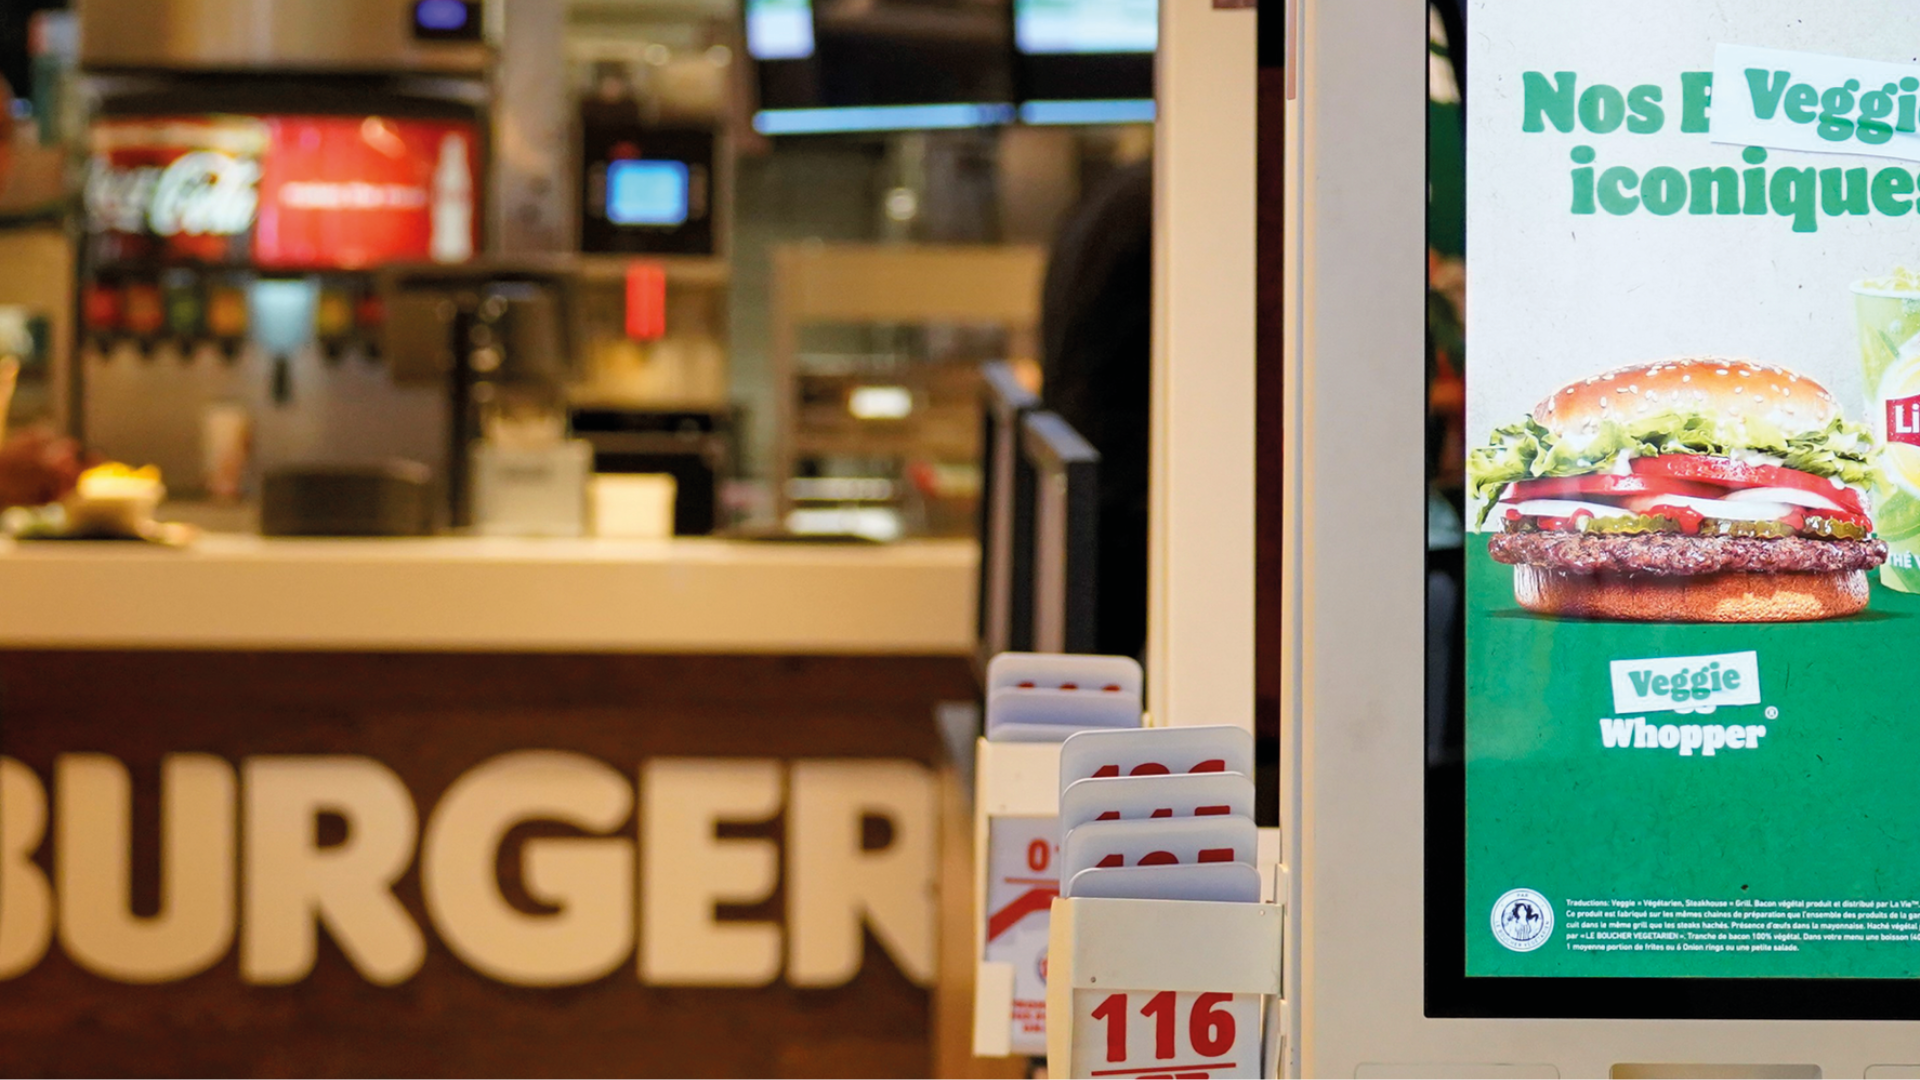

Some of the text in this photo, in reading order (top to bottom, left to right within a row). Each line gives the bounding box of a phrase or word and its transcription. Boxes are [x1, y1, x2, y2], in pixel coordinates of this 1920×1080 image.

[1522, 71, 1665, 134] Nos
[1744, 68, 1920, 145] Veggi
[1570, 145, 1920, 233] iconique
[1628, 661, 1741, 702] Veggie
[1611, 899, 1635, 907] Veggie
[1685, 899, 1727, 907] Steakhouse
[1753, 899, 1776, 907] Bacon
[1777, 900, 1804, 908] végétal
[1805, 900, 1831, 908] produit
[1576, 910, 1602, 918] produit
[1616, 910, 1647, 918] fabriqué
[1732, 910, 1742, 918] de
[1857, 911, 1887, 919] produits
[1632, 921, 1647, 929] grill
[1890, 922, 1917, 931] végétal
[1596, 931, 1632, 939] BOUCHER
[1802, 932, 1821, 940] Dans
[1605, 943, 1632, 951] portion
[1704, 943, 1724, 952] rings
[1091, 990, 1236, 1063] 116
